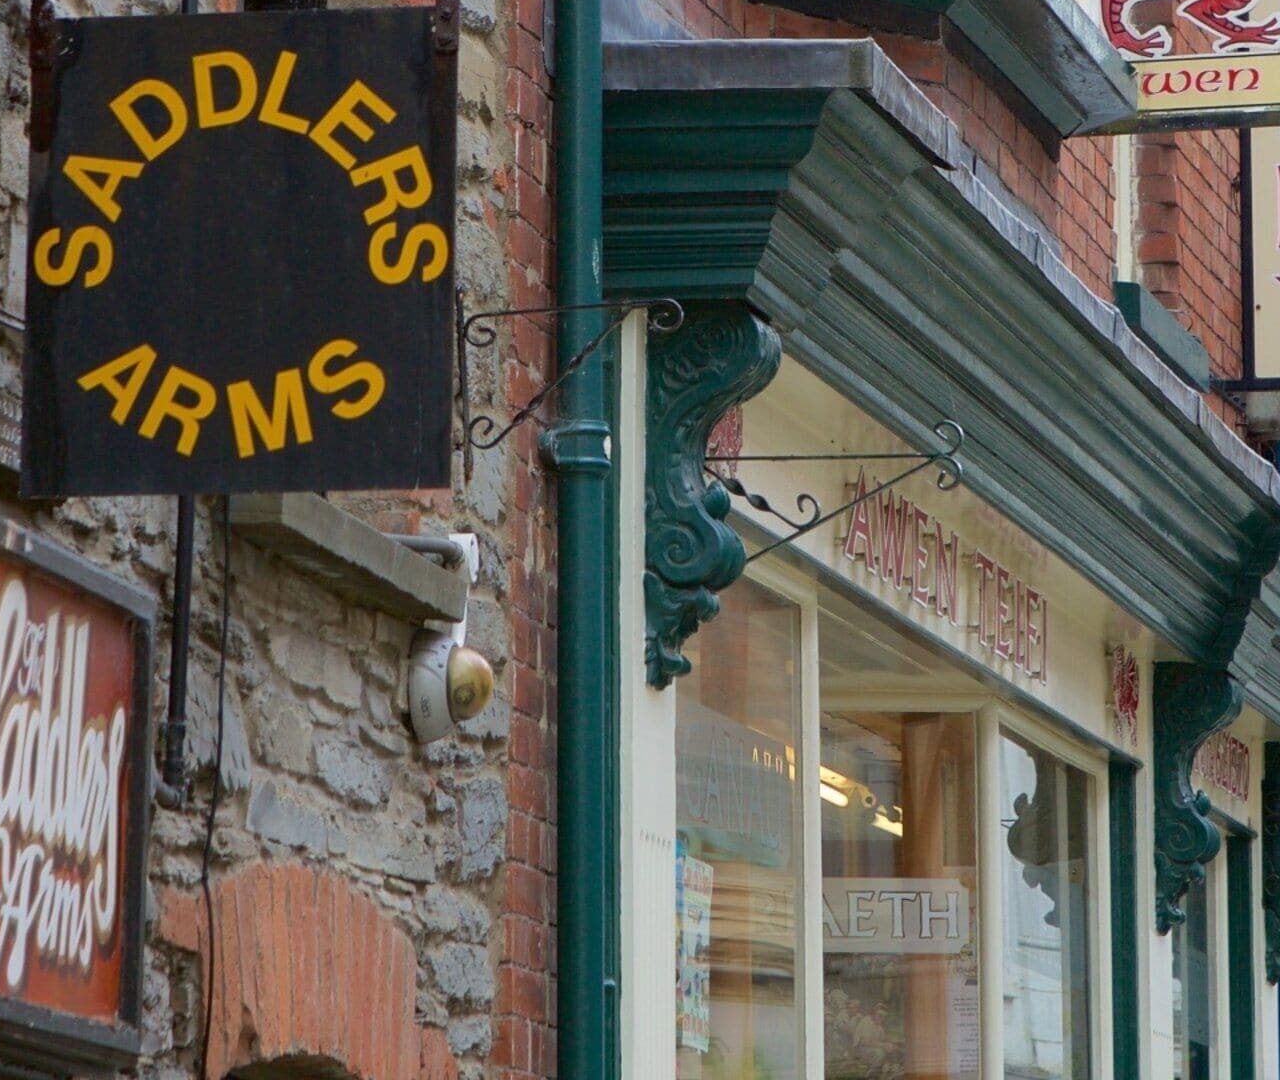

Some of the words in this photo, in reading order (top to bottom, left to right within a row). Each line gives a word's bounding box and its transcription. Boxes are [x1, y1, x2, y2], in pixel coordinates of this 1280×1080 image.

[33, 50, 449, 287] SADDLERS
[77, 338, 386, 459] ARMS
[843, 465, 959, 627] AWEN
[975, 548, 1047, 687] TEIFI
